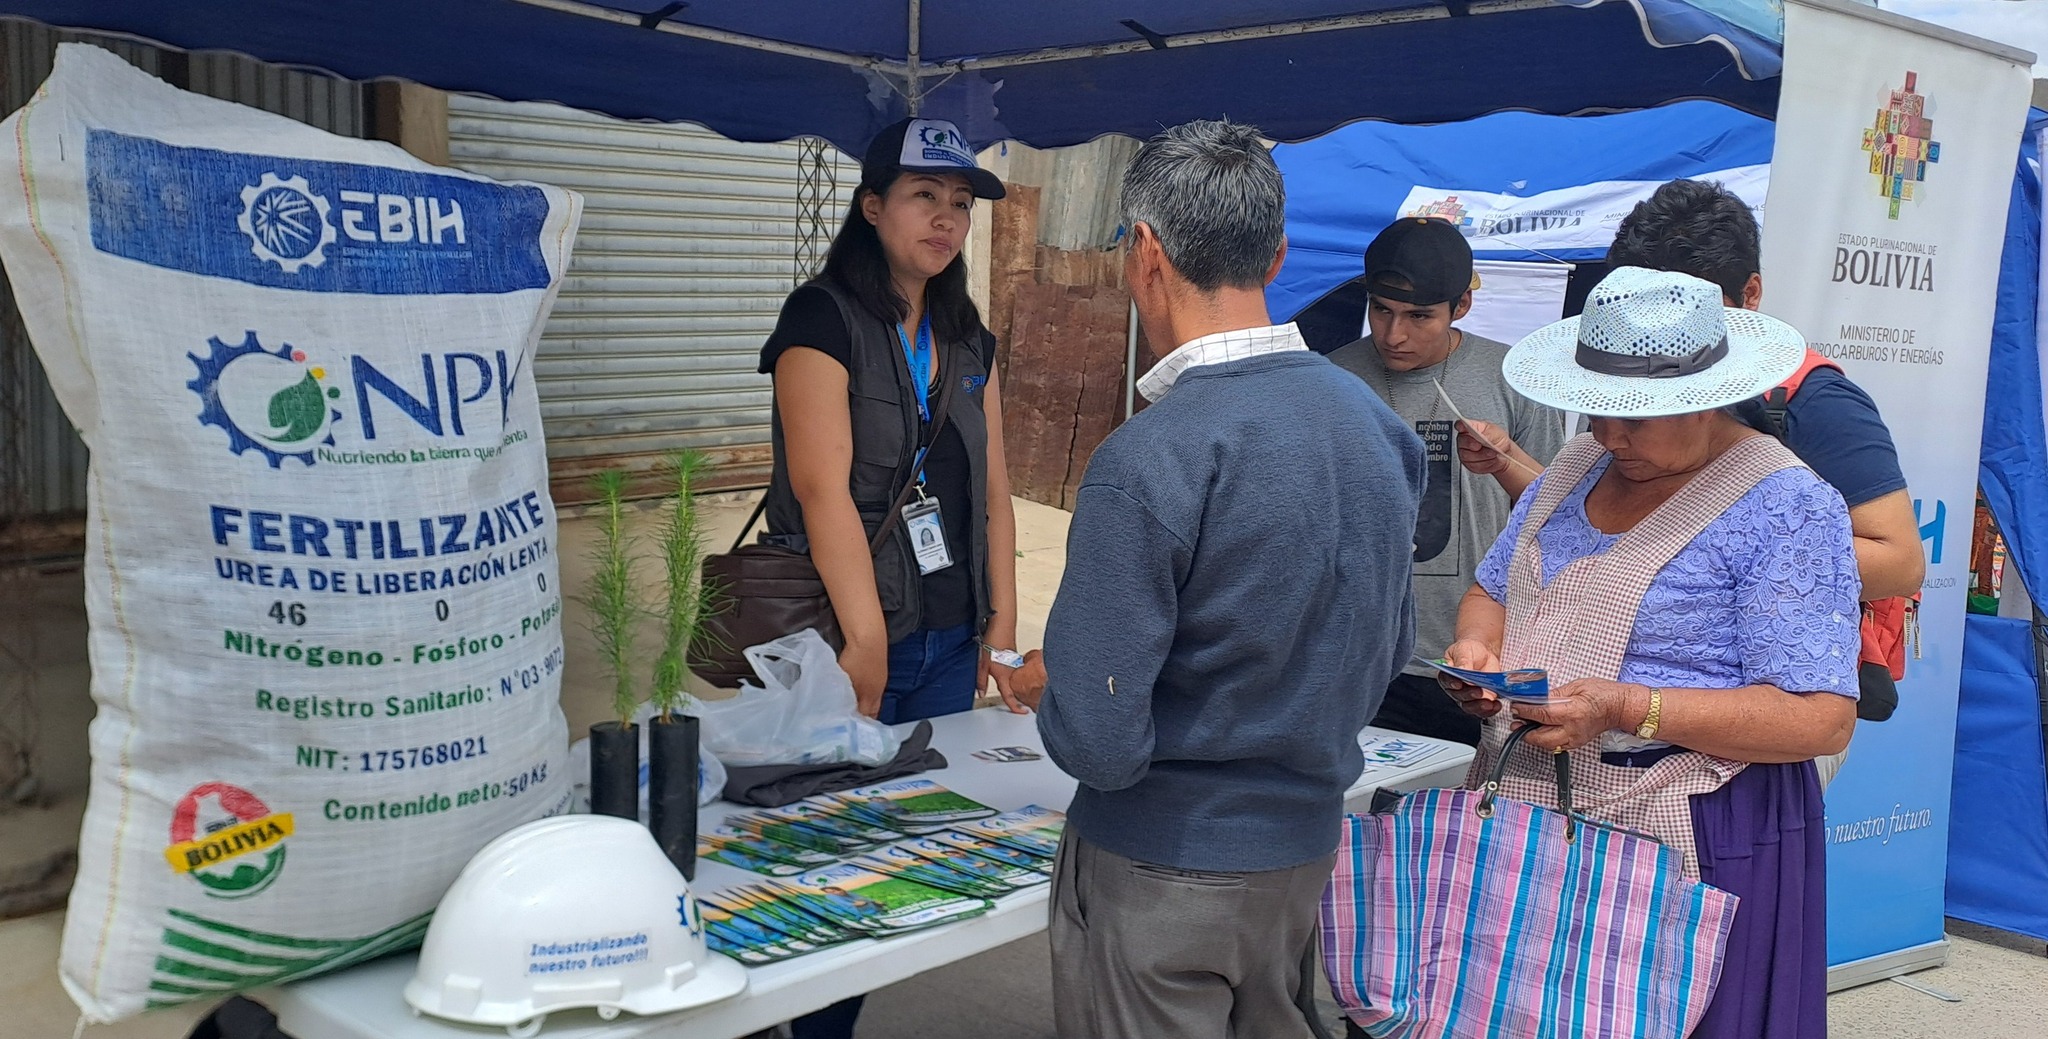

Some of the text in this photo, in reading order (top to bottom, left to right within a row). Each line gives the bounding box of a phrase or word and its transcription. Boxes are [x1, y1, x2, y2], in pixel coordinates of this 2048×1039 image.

[340, 189, 466, 244] EBIH
[1478, 216, 1582, 237] BOLIVIA
[1575, 209, 1586, 217] DE
[1838, 232, 1938, 256] ESTADO PLURINACIONAL DE
[1832, 246, 1934, 292] BOLIVIA
[1840, 324, 1916, 345] MINISTERIO DE
[1891, 347, 1898, 363] Y
[1900, 346, 1944, 366] ENERGÍAS
[317, 446, 407, 465] Nutriendo
[410, 449, 426, 463] la
[428, 446, 471, 461] tierra
[474, 447, 496, 462] que
[208, 490, 544, 560] FERTILIZANTE
[214, 538, 550, 596] UREA DE LIBERACIÓN LENTA
[267, 572, 547, 626] 46 0 0
[223, 629, 385, 668] Nitrógeno
[412, 634, 504, 664] Fósforo
[255, 688, 375, 720] Registro
[385, 683, 492, 718] Sanitario:
[296, 735, 489, 774] NIT: 175768021
[323, 793, 452, 822] Contenido
[1833, 815, 1885, 844] nuestro
[1882, 803, 1932, 845] futuro.
[185, 821, 285, 868] BOLIVIA
[528, 948, 649, 974] nuestro futuro!!!
[529, 932, 648, 957] Industrializando
